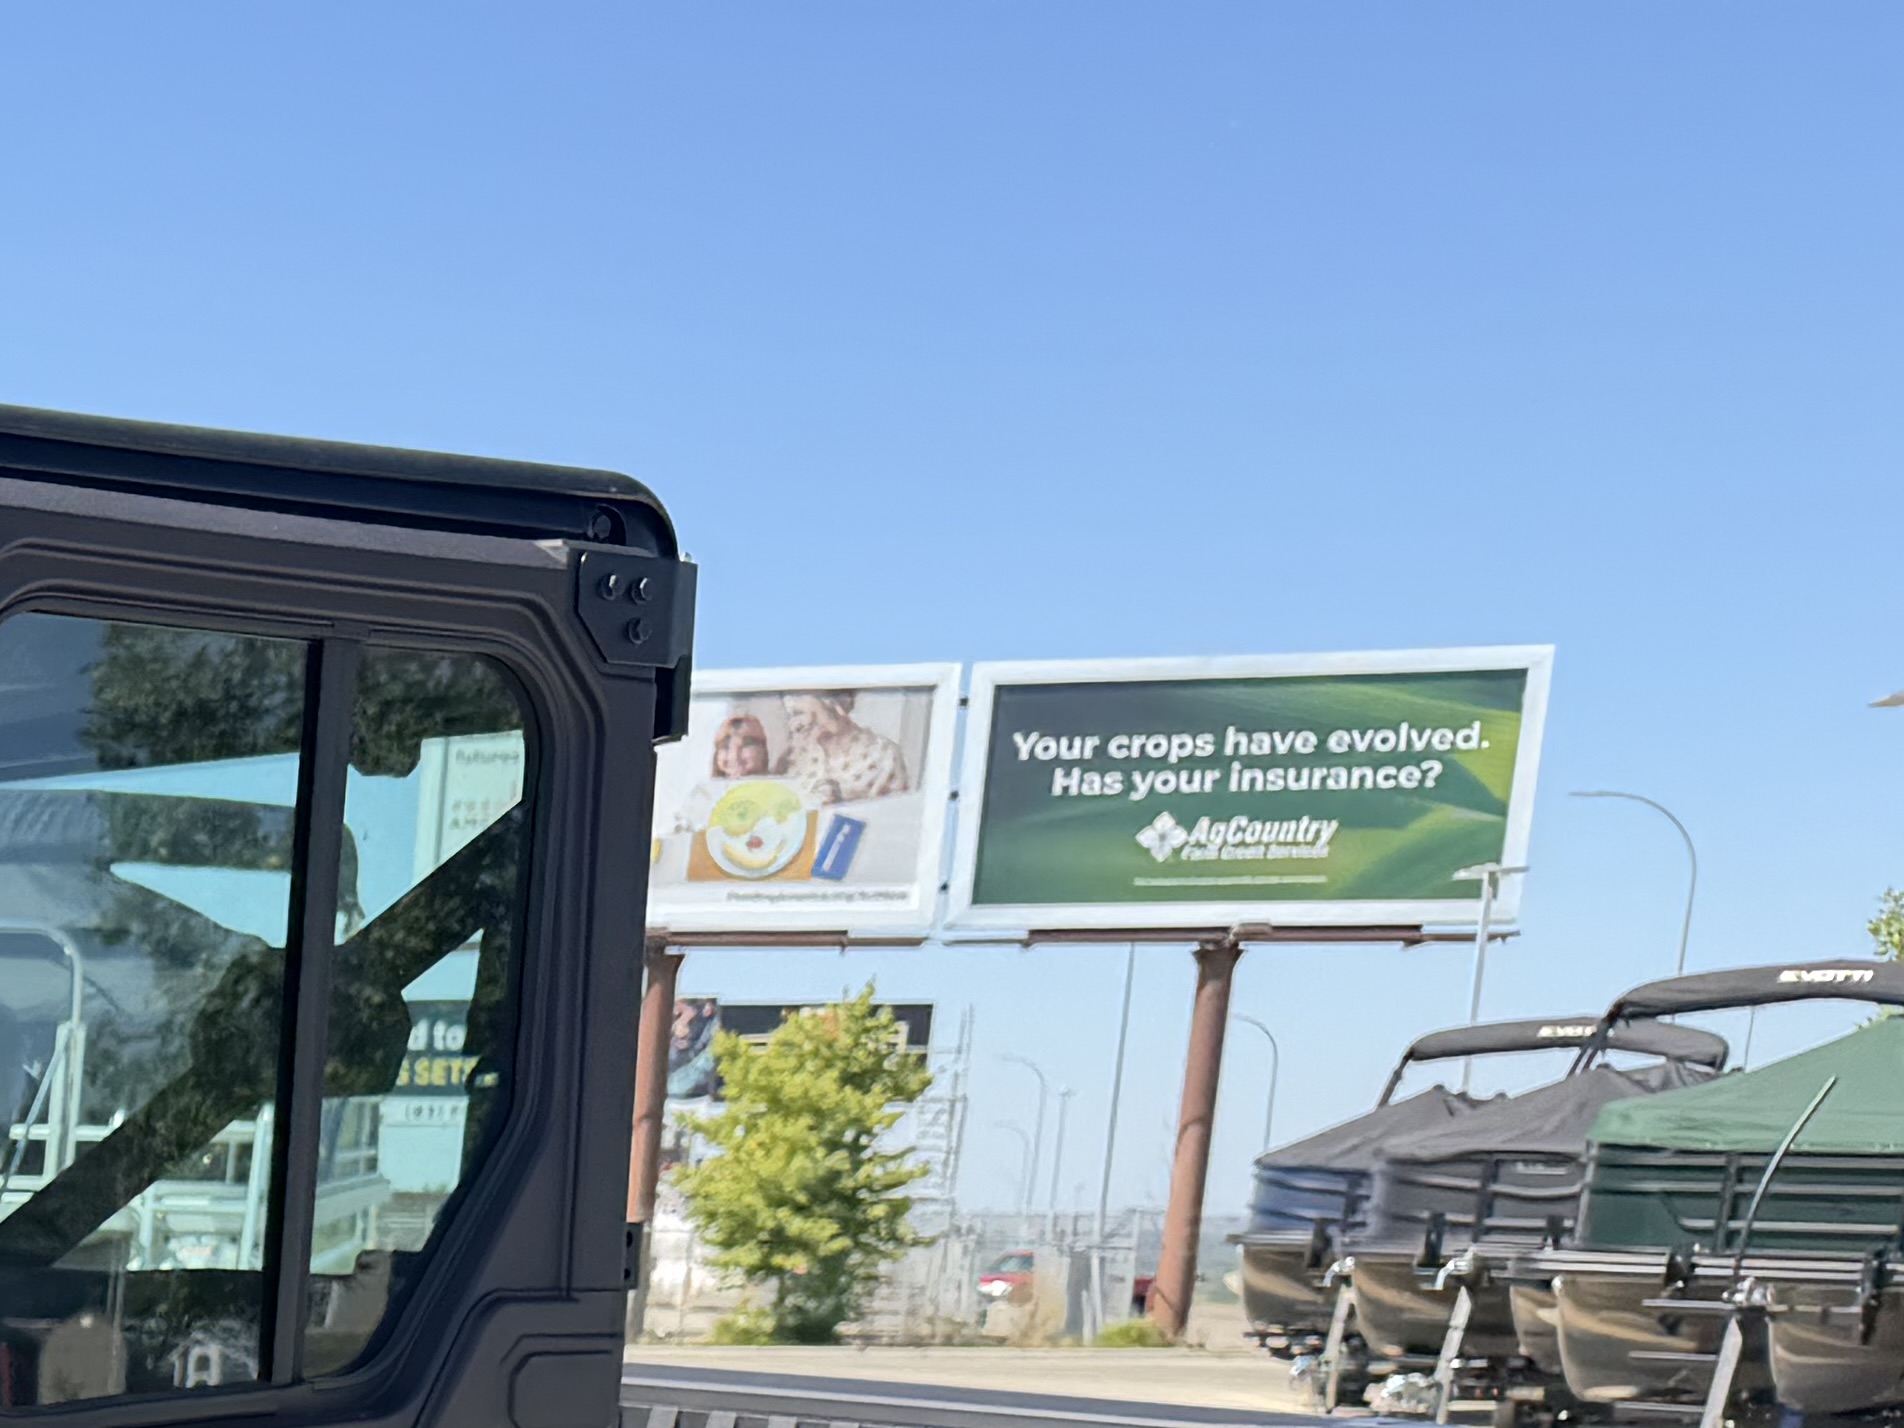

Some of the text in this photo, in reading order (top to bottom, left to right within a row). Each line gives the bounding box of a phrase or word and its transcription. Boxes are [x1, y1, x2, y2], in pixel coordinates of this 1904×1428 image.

[1012, 720, 1491, 764] Your crops have evolved.
[1051, 759, 1444, 801] Has your insurance?
[1187, 815, 1340, 851] AgCountry
